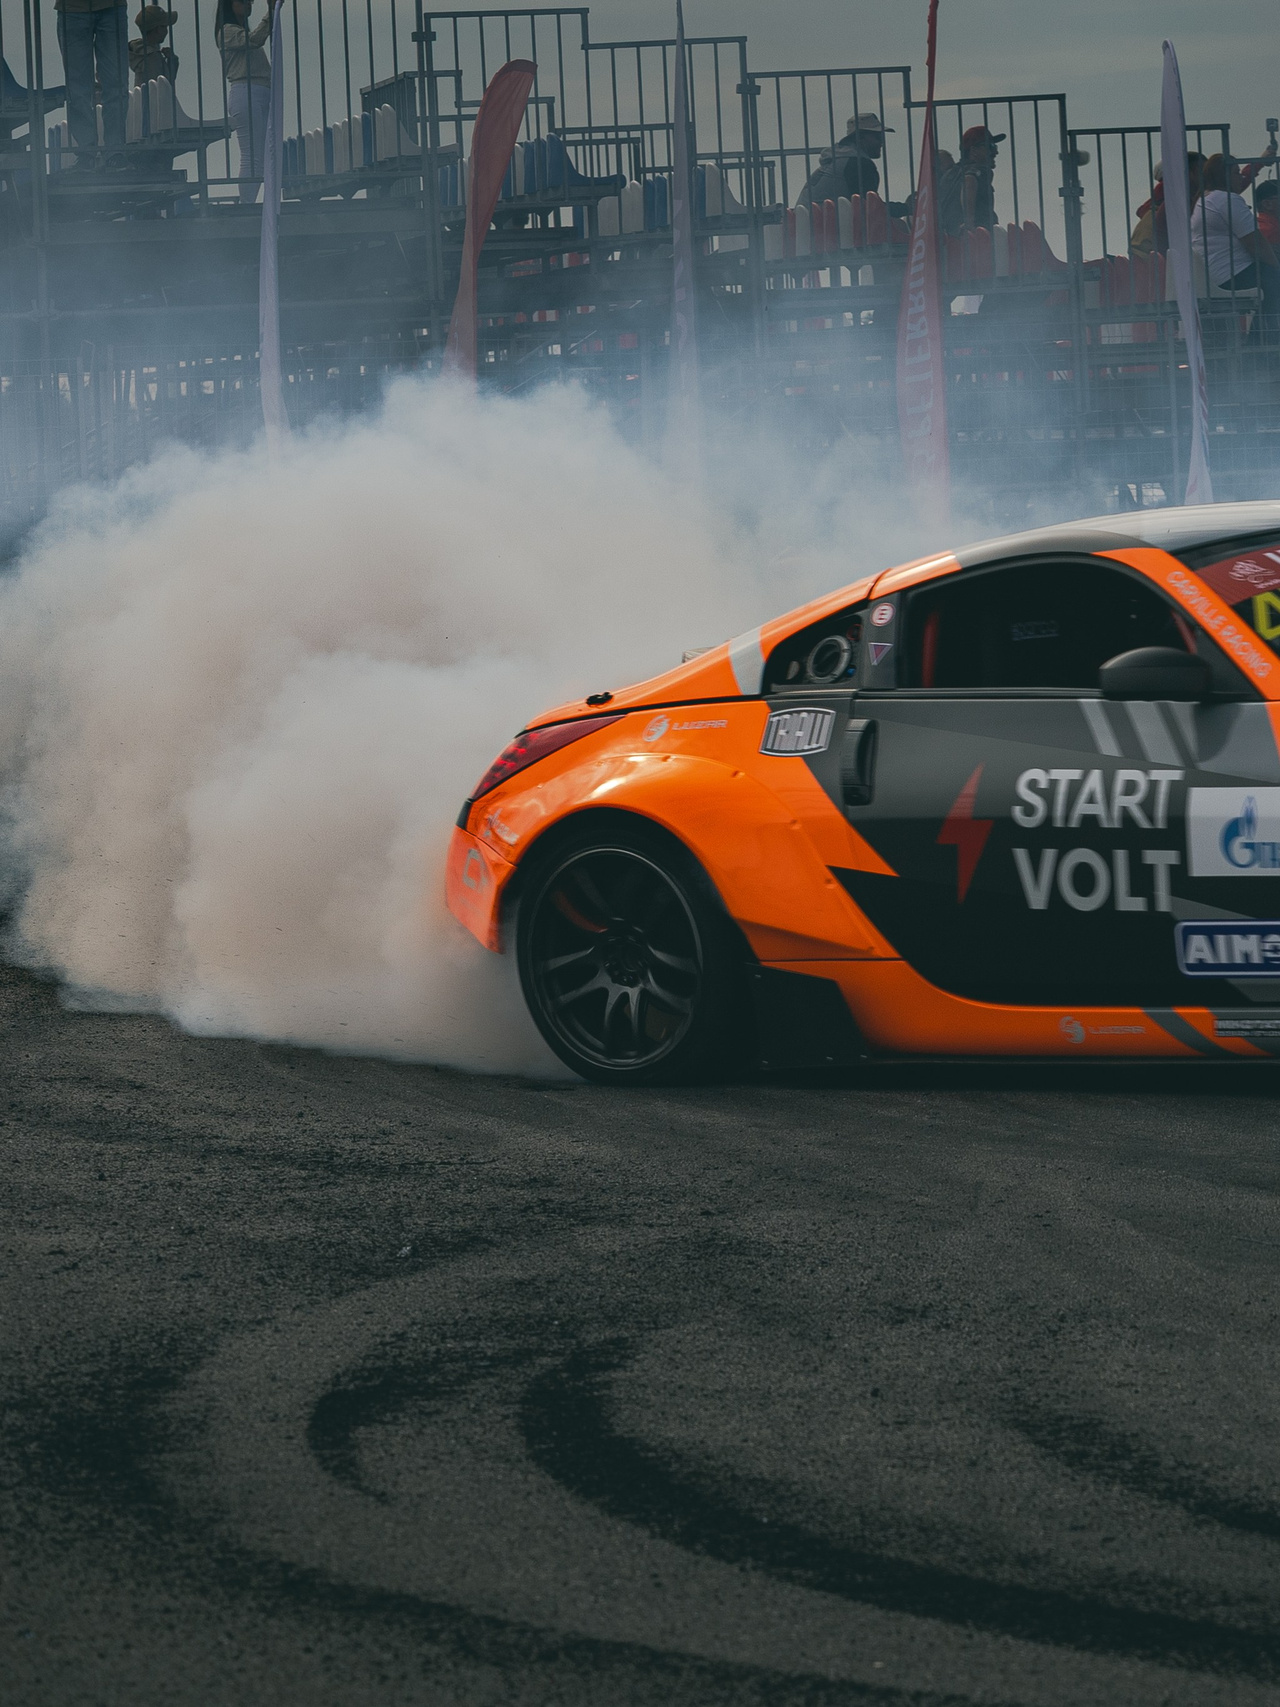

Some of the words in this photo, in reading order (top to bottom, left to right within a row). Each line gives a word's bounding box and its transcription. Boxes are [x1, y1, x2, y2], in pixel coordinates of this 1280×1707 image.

[1217, 624, 1273, 678] RACING
[1010, 768, 1185, 829] START
[1010, 847, 1182, 912] VOLT
